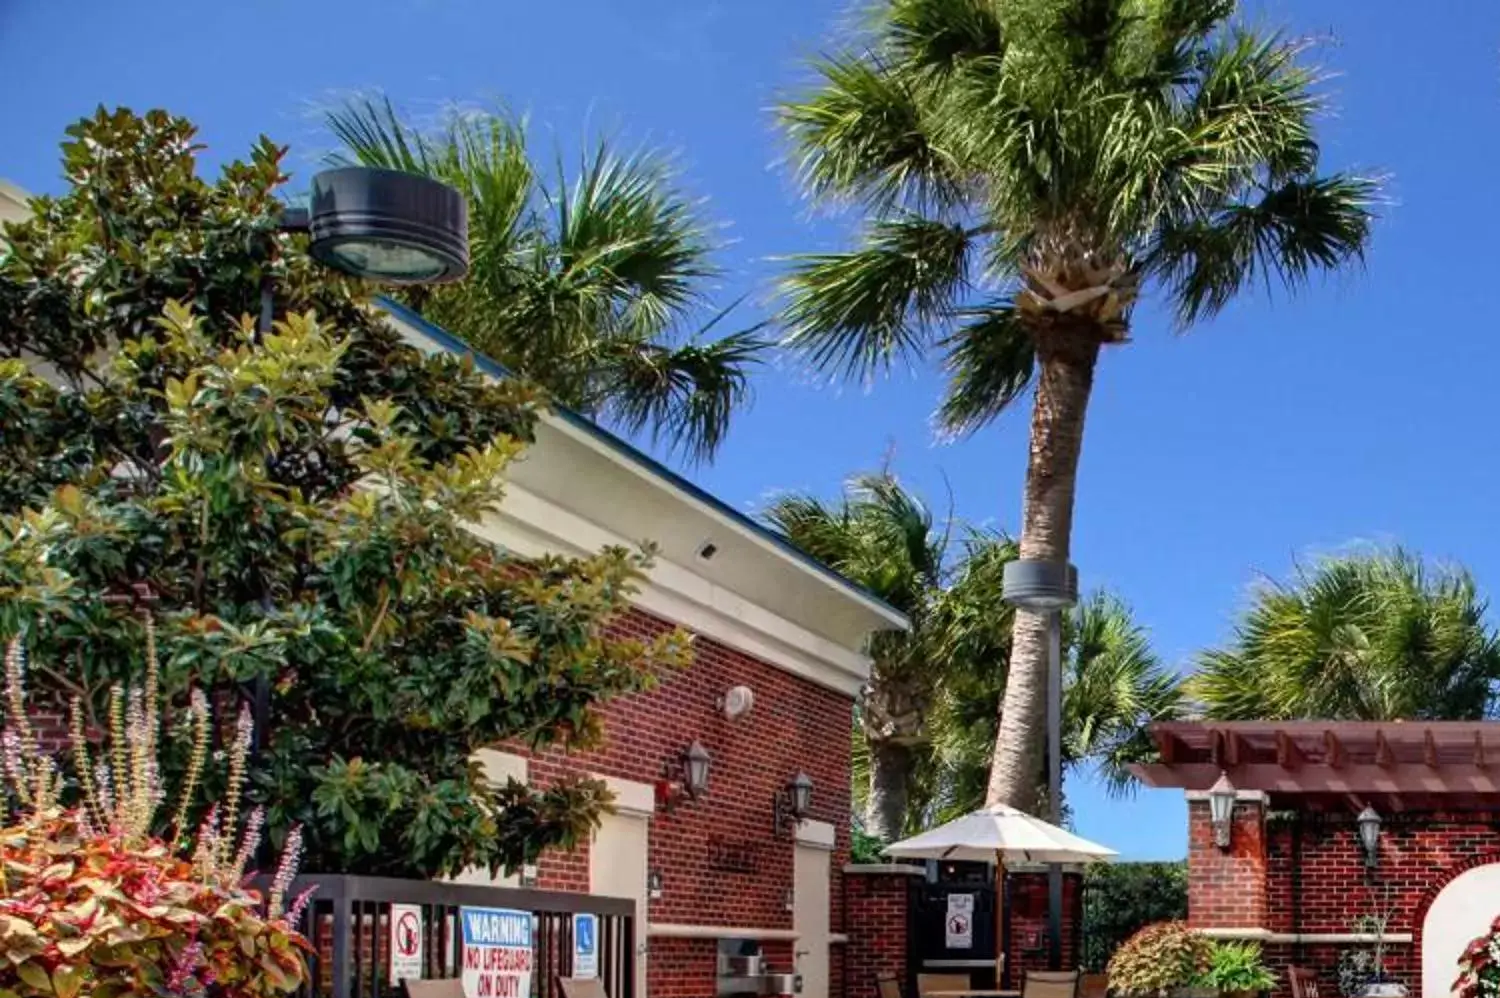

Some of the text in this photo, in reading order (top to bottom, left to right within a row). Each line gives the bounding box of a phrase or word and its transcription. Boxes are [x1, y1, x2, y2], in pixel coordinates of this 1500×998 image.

[468, 913, 529, 945] WARNING
[465, 946, 530, 972] NO LIFEGUARD
[478, 973, 520, 998] ON DUTY
